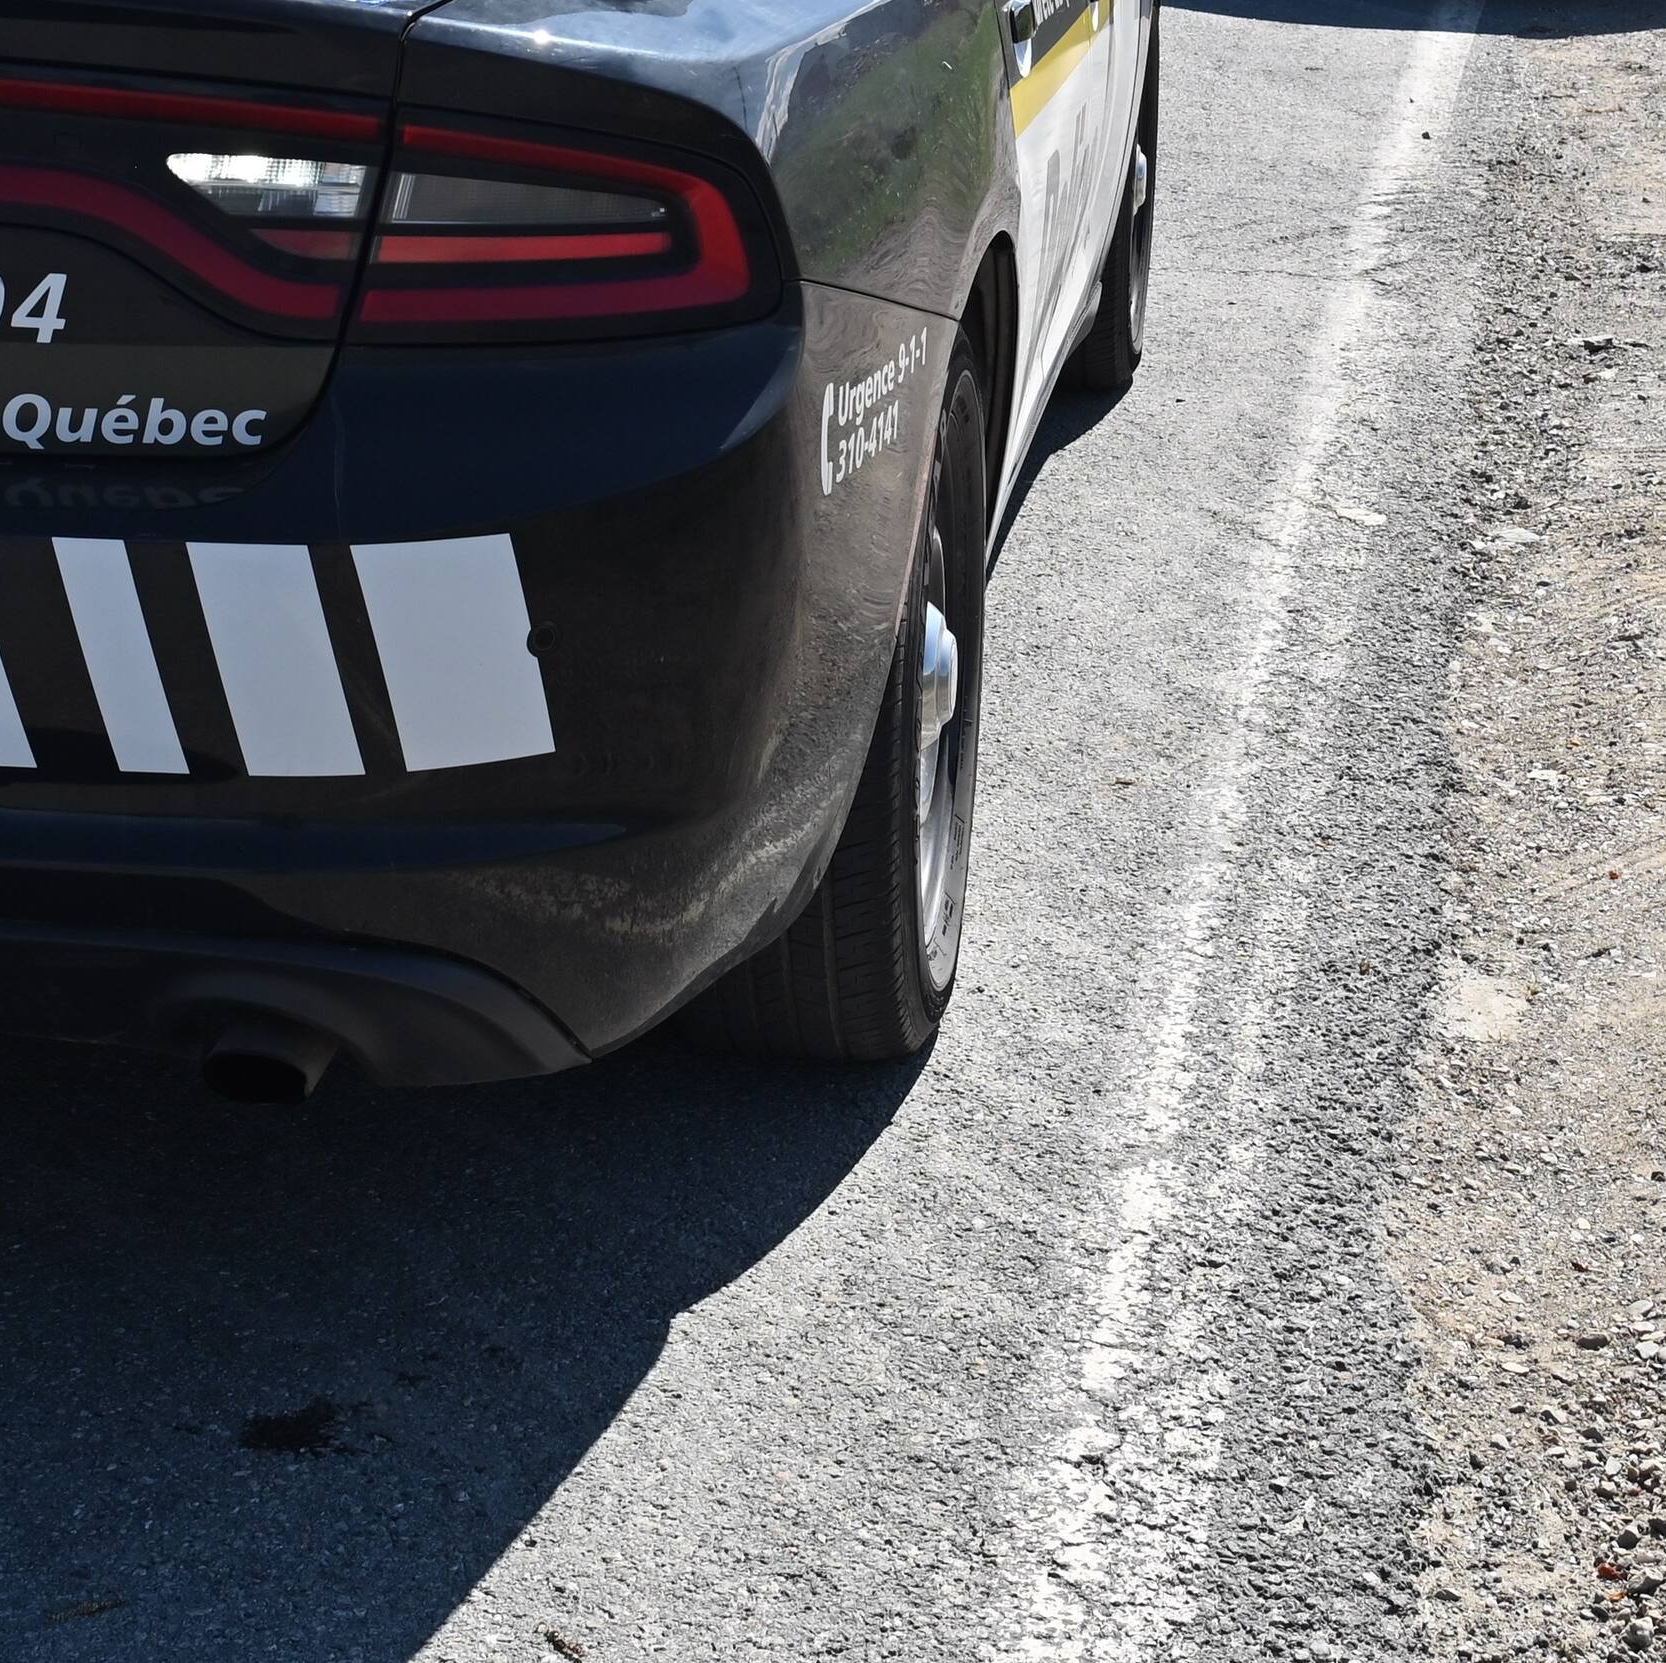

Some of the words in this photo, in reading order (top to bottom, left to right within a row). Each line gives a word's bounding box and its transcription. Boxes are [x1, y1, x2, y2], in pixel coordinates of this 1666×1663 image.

[838, 360, 895, 426] Urgence
[898, 327, 927, 383] 9-1-1
[2, 392, 267, 450] Québec
[836, 400, 899, 483] 310-4141
